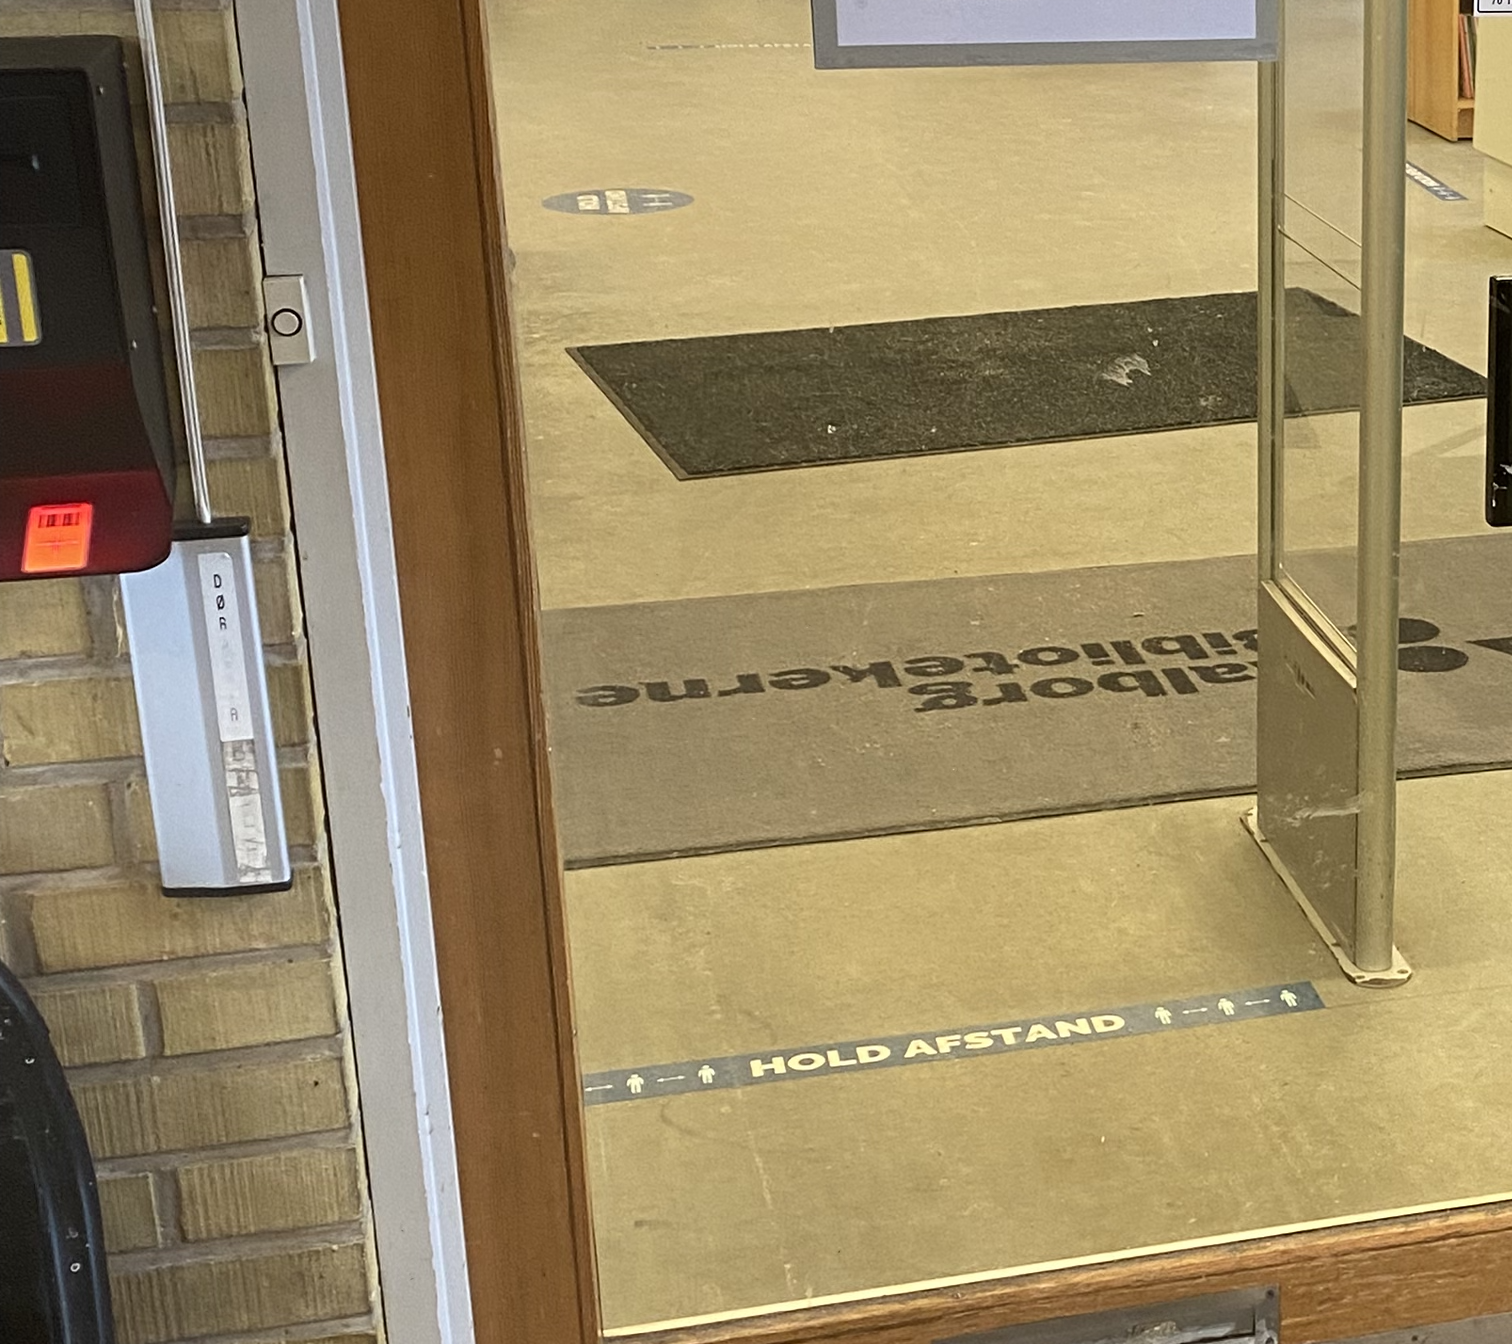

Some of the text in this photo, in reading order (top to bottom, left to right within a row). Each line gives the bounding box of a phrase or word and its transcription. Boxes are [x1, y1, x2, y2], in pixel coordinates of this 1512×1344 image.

[913, 658, 1258, 713] alborg
[749, 1013, 1126, 1078] HOLD AFSTAND
